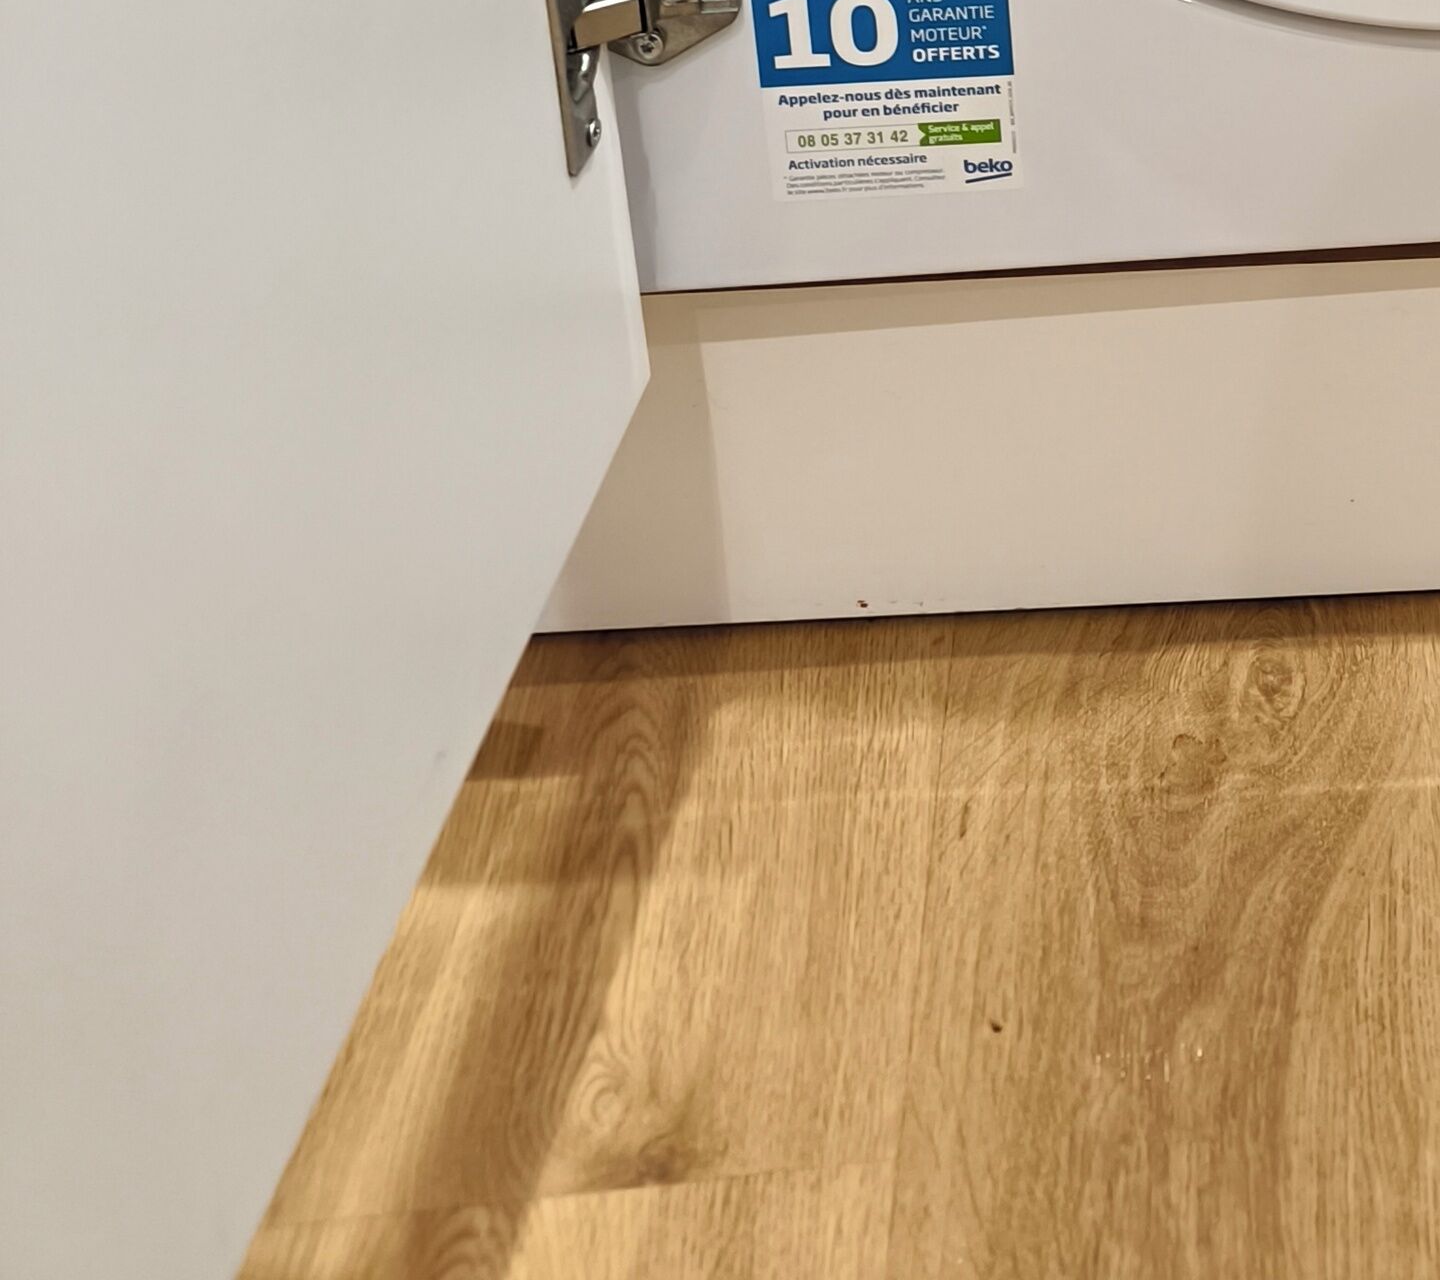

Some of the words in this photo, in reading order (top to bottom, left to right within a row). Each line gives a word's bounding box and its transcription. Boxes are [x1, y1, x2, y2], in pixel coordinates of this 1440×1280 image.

[909, 5, 994, 23] GARANTIE
[912, 45, 1000, 62] OFFERTS
[778, 91, 881, 108] Appelez-nous
[884, 87, 912, 100] dès
[914, 84, 1001, 98] maintenant
[823, 107, 858, 121] pour
[861, 107, 880, 117] en
[883, 102, 959, 116] bénéficier
[797, 135, 816, 147] 08
[821, 134, 839, 146] 05
[844, 132, 862, 145] 37
[867, 131, 884, 144] 31
[890, 130, 908, 143] 42
[788, 156, 855, 171] Activation
[858, 153, 927, 168] nécessaire
[963, 158, 1013, 174] beko
